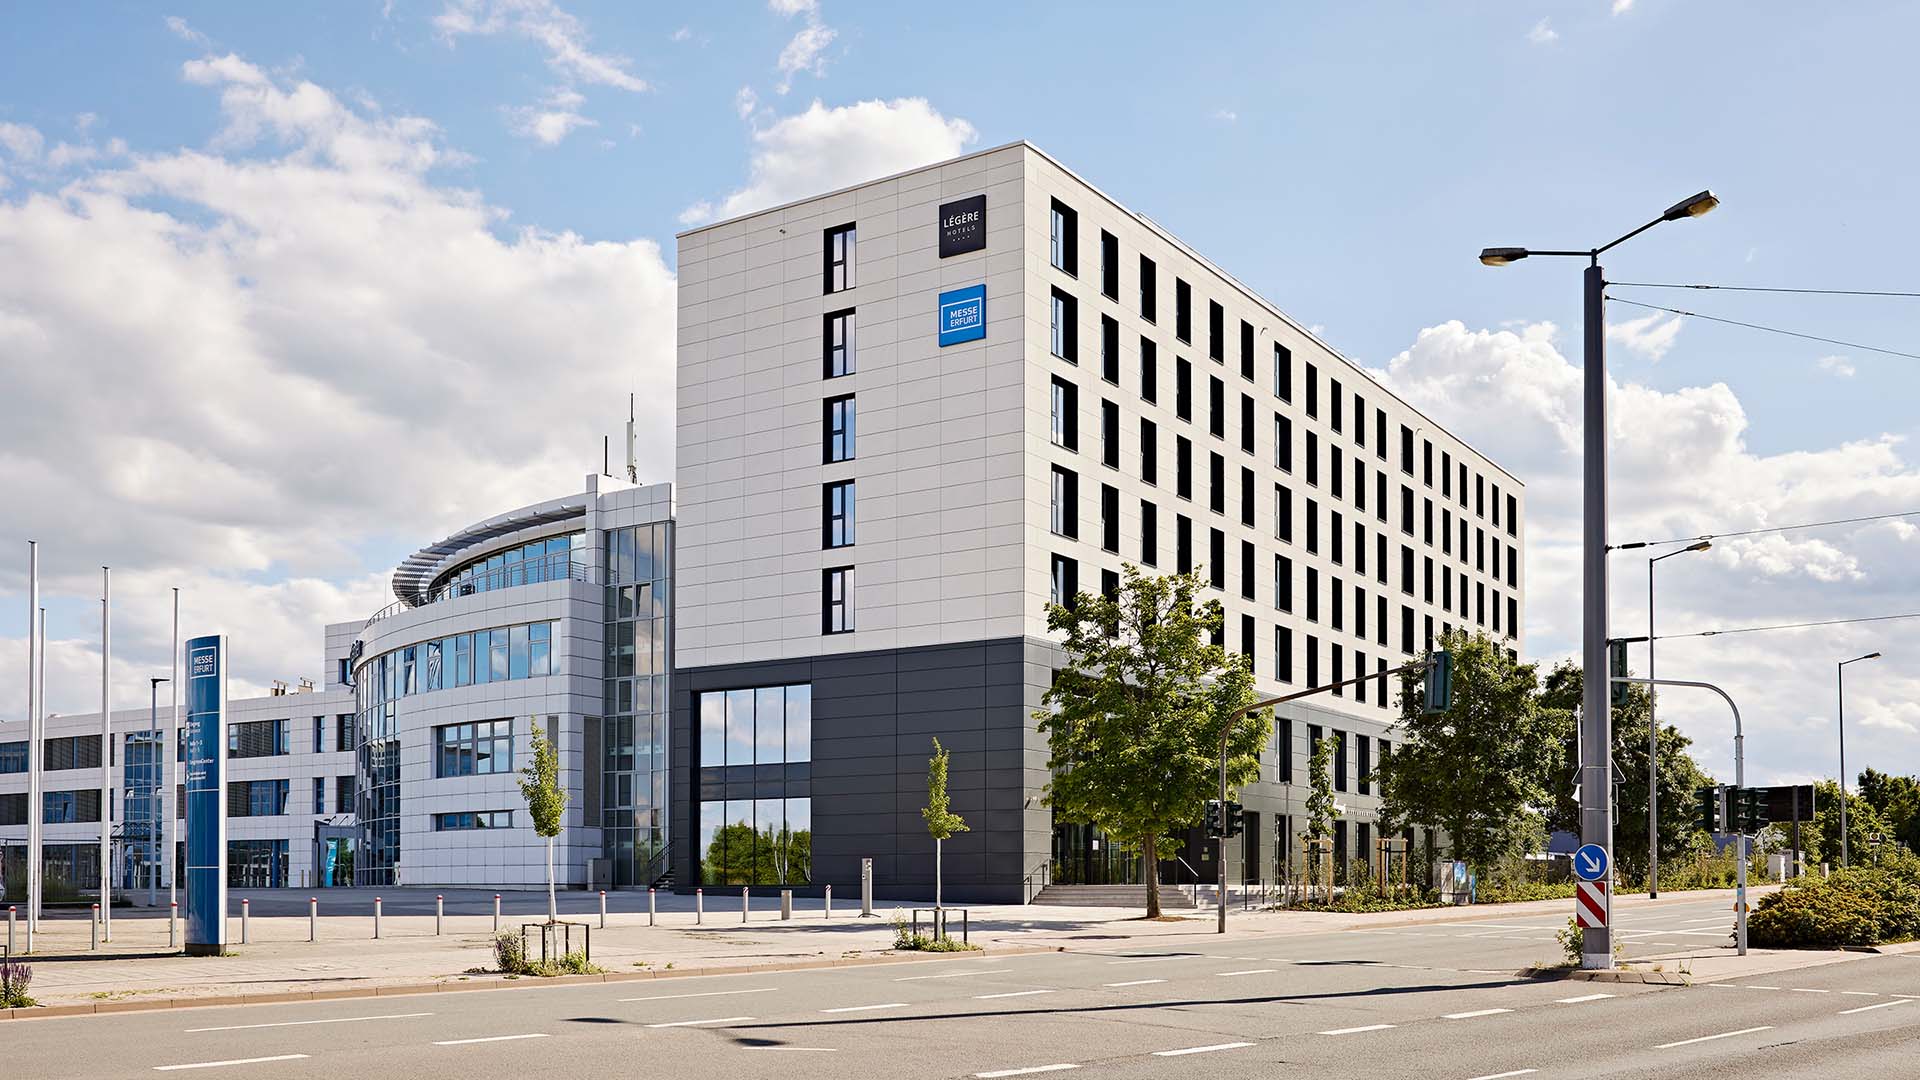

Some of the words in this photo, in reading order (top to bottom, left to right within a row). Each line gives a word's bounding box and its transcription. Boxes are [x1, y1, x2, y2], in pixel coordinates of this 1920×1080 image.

[943, 211, 979, 228] LÉGÈRE
[946, 225, 976, 236] HOTELS
[950, 306, 978, 318] MESSE
[950, 315, 978, 327] ERFURT
[193, 655, 213, 665] MESSE
[193, 663, 213, 673] ERFURT
